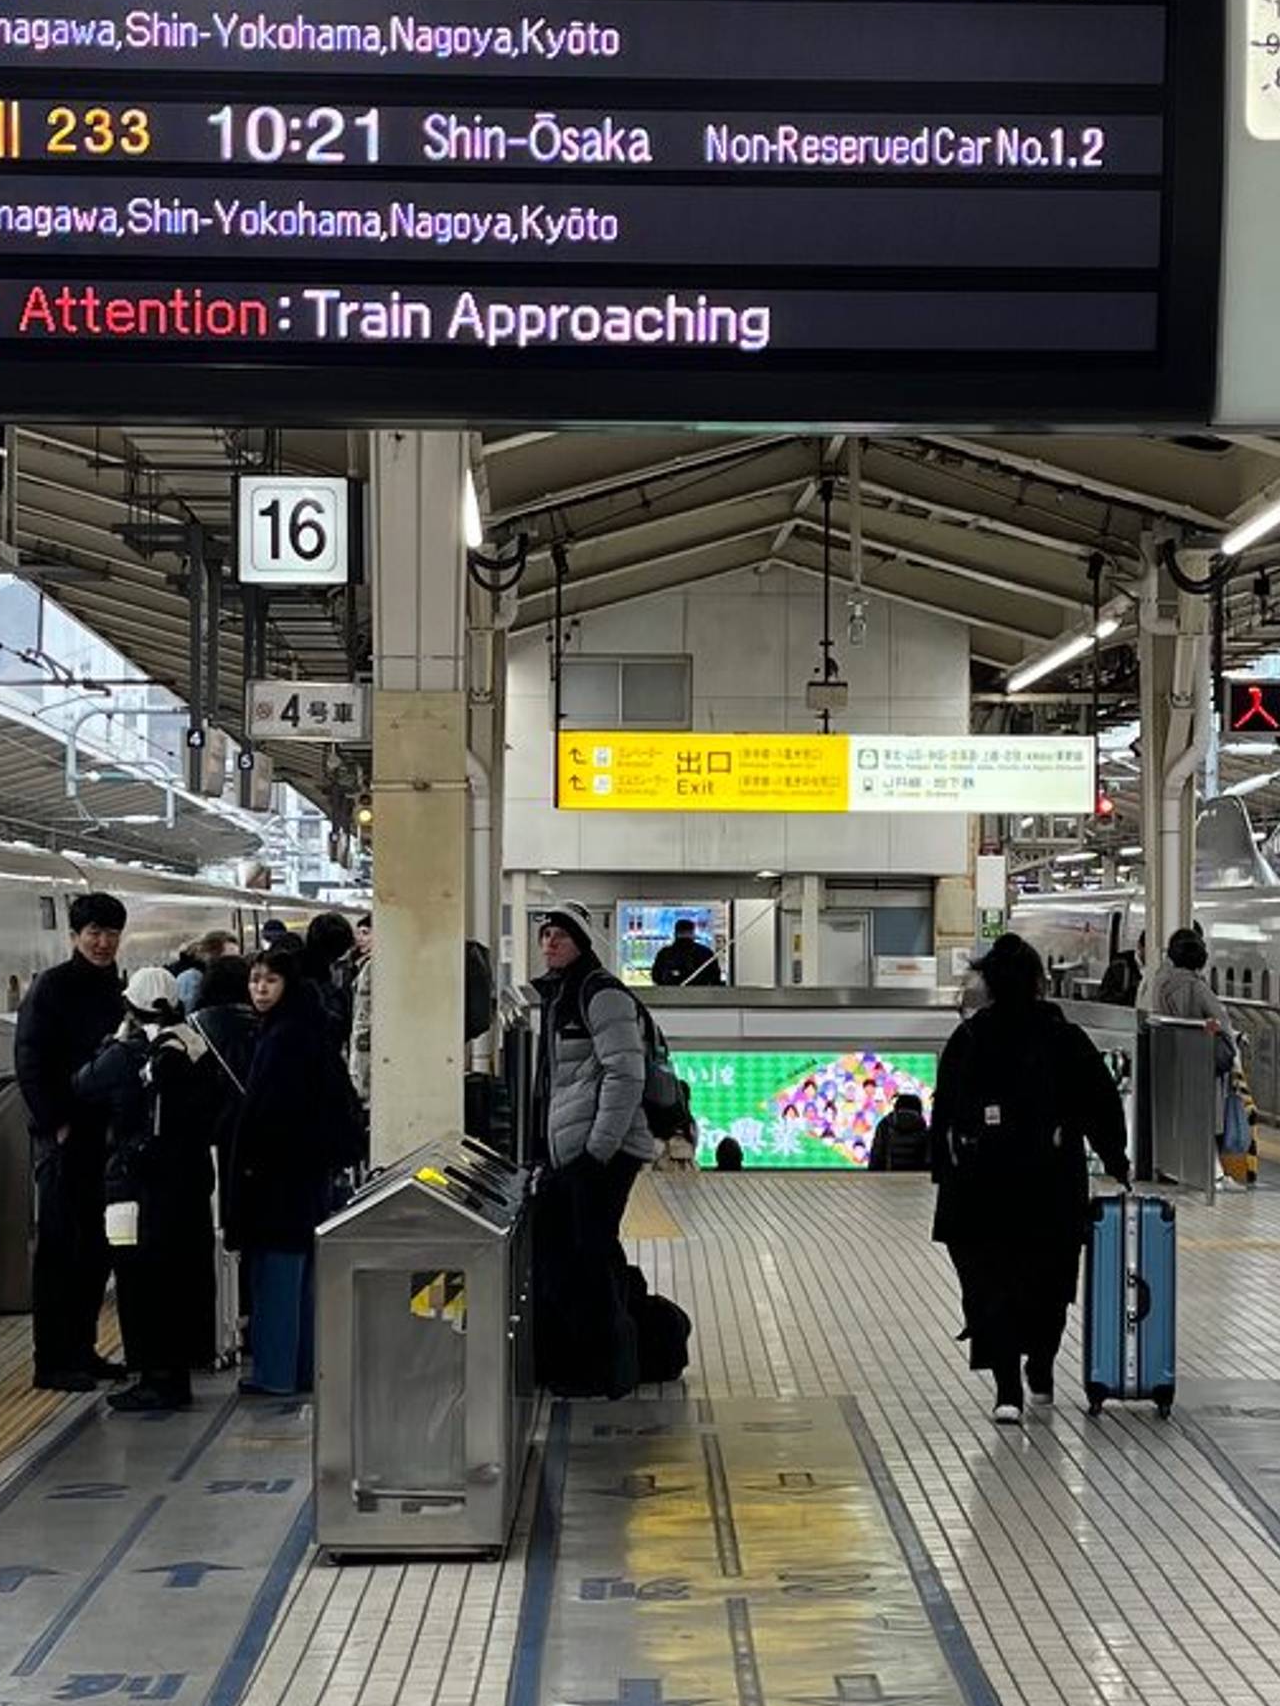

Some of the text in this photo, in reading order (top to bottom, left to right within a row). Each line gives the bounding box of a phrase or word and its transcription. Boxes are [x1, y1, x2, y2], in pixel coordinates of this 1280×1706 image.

[1266, 33, 1280, 56] 9
[48, 108, 149, 153] 233
[208, 106, 378, 162] 10:21
[424, 113, 652, 163] Shin-Ōsaka
[304, 290, 430, 338] Train
[448, 292, 769, 349] Approaching
[259, 499, 327, 562] 16
[280, 693, 353, 728] 4号車
[676, 750, 732, 775] 出口
[676, 780, 714, 795] Exit
[53, 1673, 188, 1701] 列
